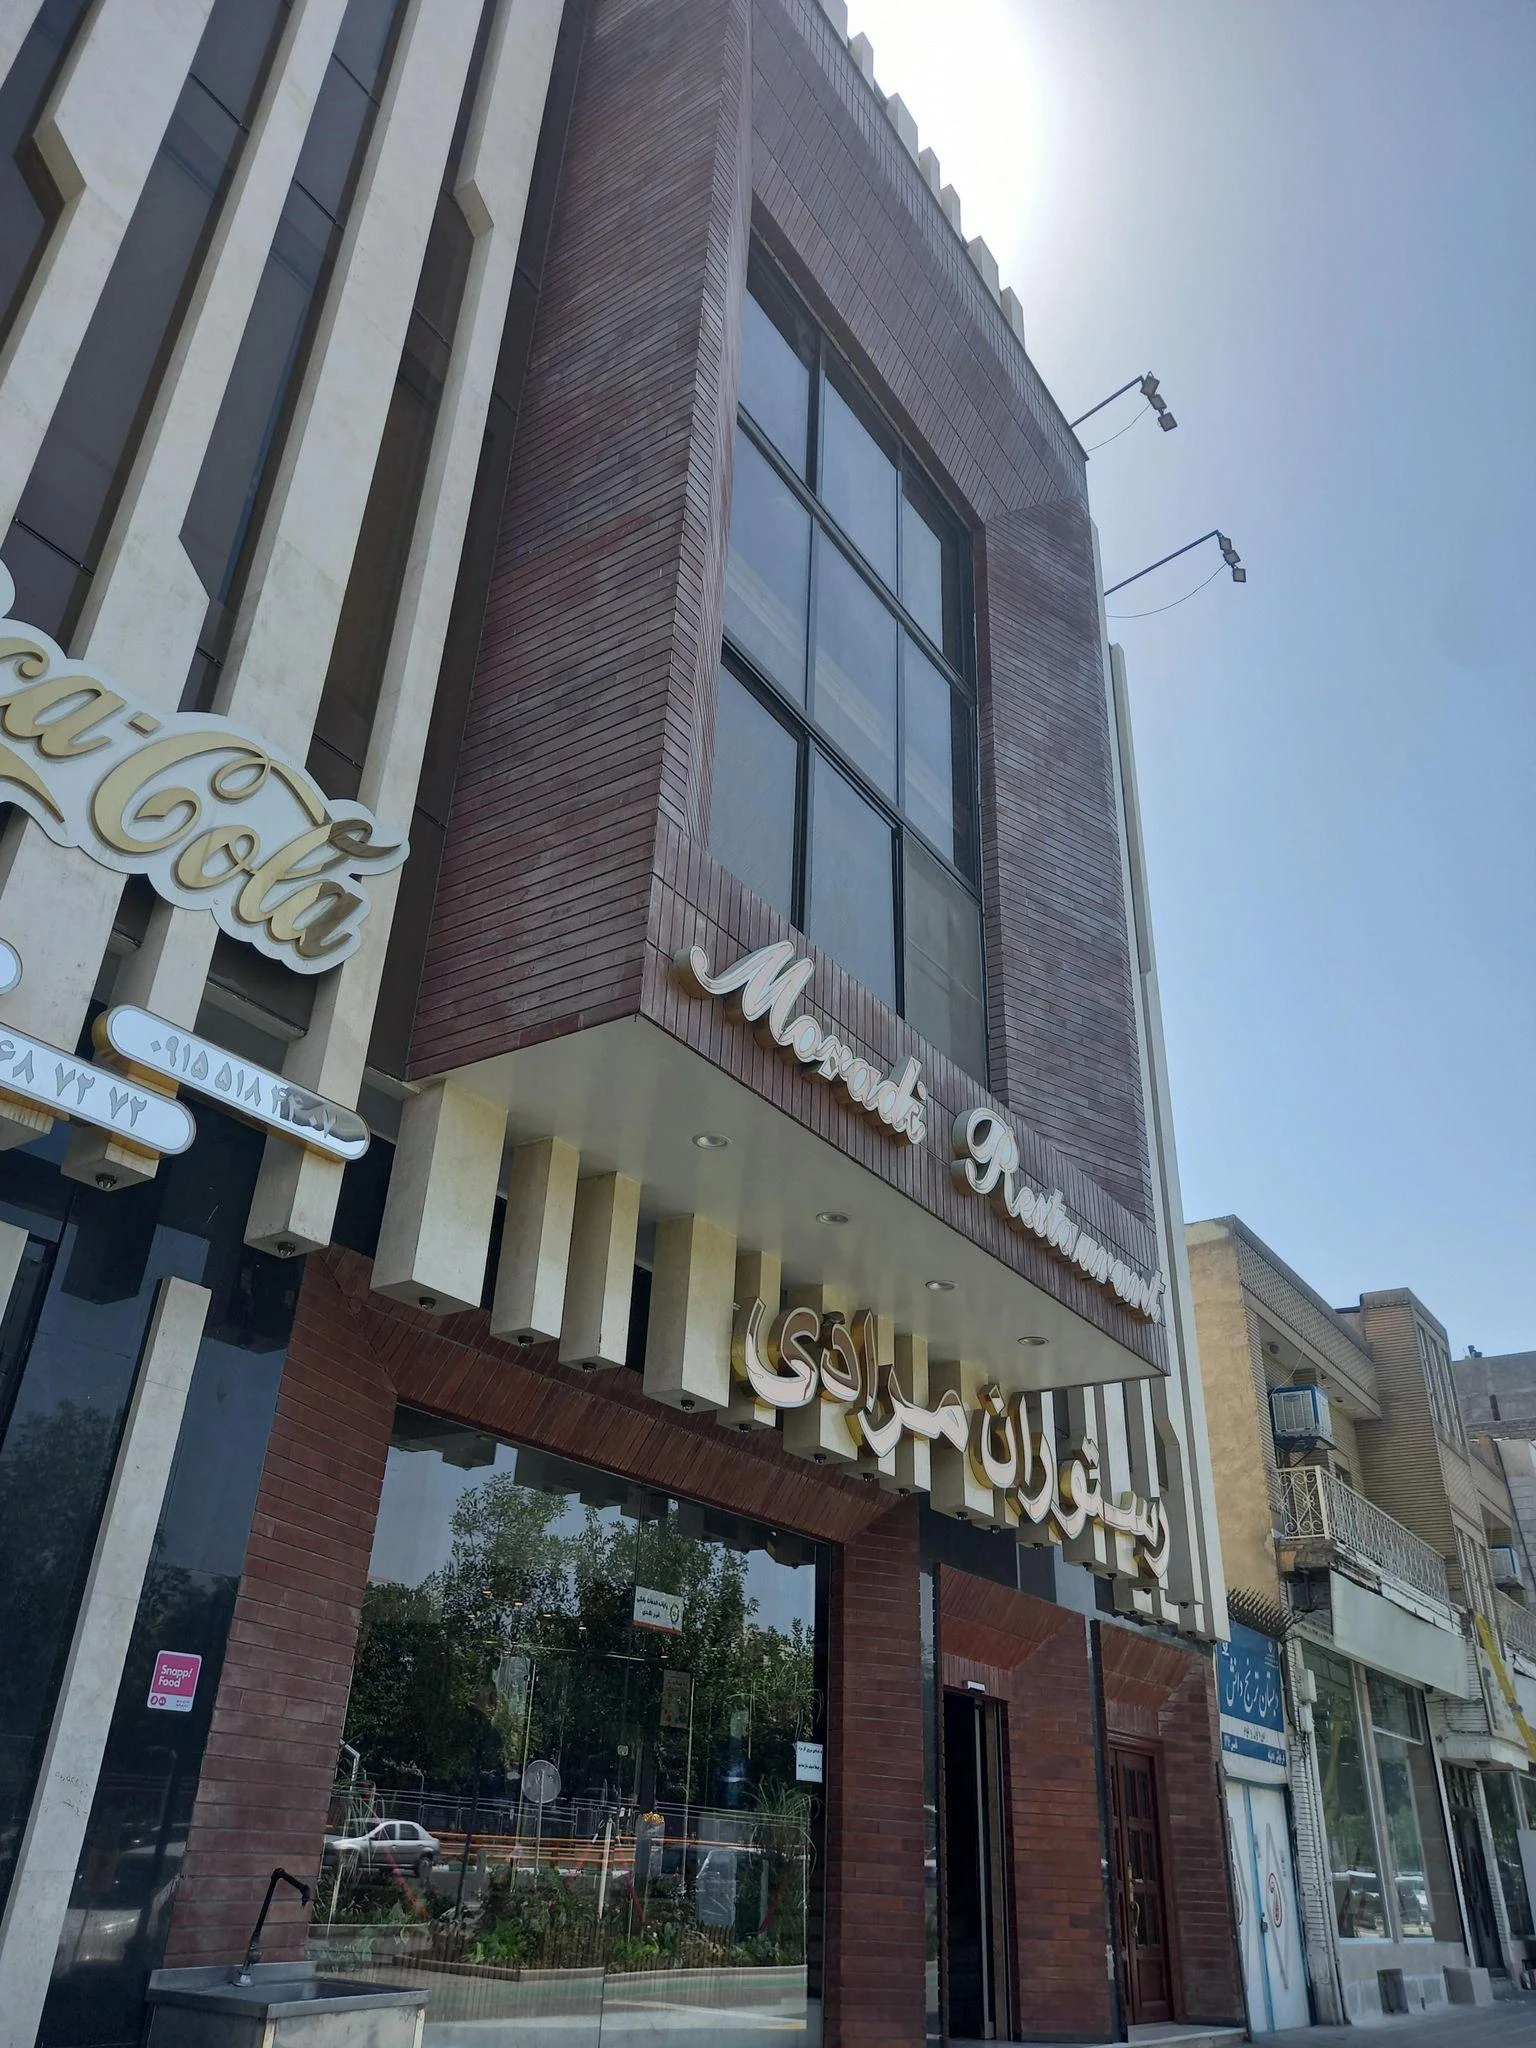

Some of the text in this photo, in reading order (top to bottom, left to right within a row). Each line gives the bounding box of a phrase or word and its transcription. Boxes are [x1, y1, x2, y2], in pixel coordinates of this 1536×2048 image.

[54, 1062, 96, 1105] ۷۲
[108, 1086, 148, 1128] ۷۲
[150, 1035, 209, 1081] ۰۹۱۵
[214, 1061, 262, 1107] ۵۱۸
[685, 940, 1166, 1323] Moradi Restaurant
[743, 1297, 1170, 1579] رستوران مرادی
[159, 1676, 181, 1687] Food
[161, 1665, 193, 1678] Snapp!
[1225, 1656, 1244, 1707] دانش
[1258, 1670, 1279, 1719] دبستان
